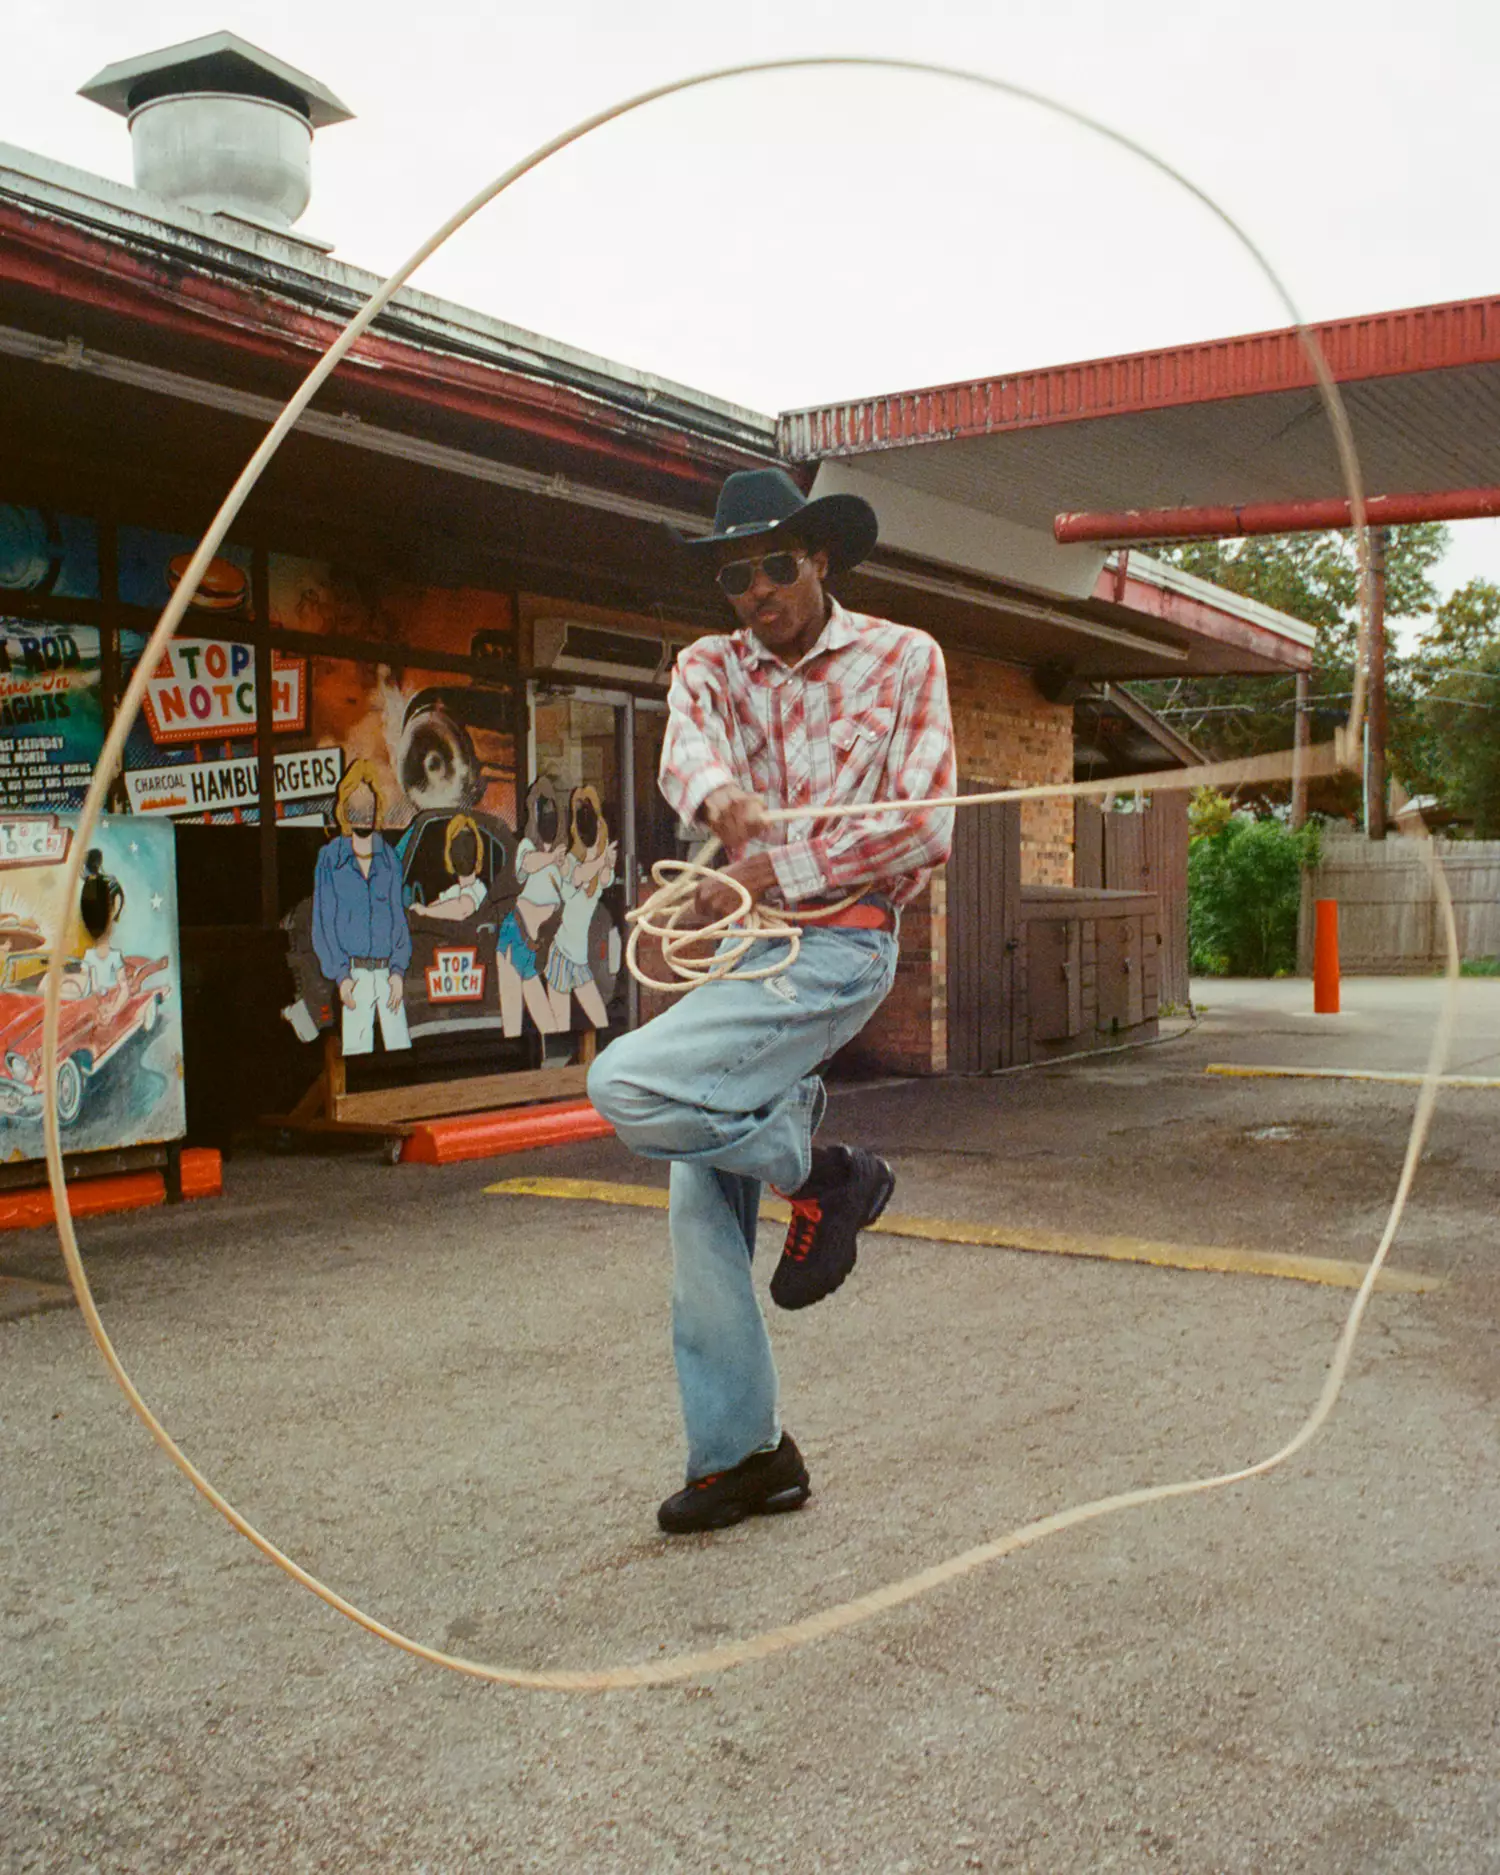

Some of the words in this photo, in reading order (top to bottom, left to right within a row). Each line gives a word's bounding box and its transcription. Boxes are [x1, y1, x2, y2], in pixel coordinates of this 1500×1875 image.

[19, 635, 80, 673] ROD
[179, 644, 250, 679] TOP
[0, 671, 70, 696] ive-In
[0, 692, 71, 725] IGHTS
[158, 682, 291, 722] NOTCH
[135, 774, 186, 793] CHARCOAL
[191, 756, 337, 803] HAMBURGERS
[442, 956, 469, 973] TOP
[432, 975, 479, 993] NOTCH
